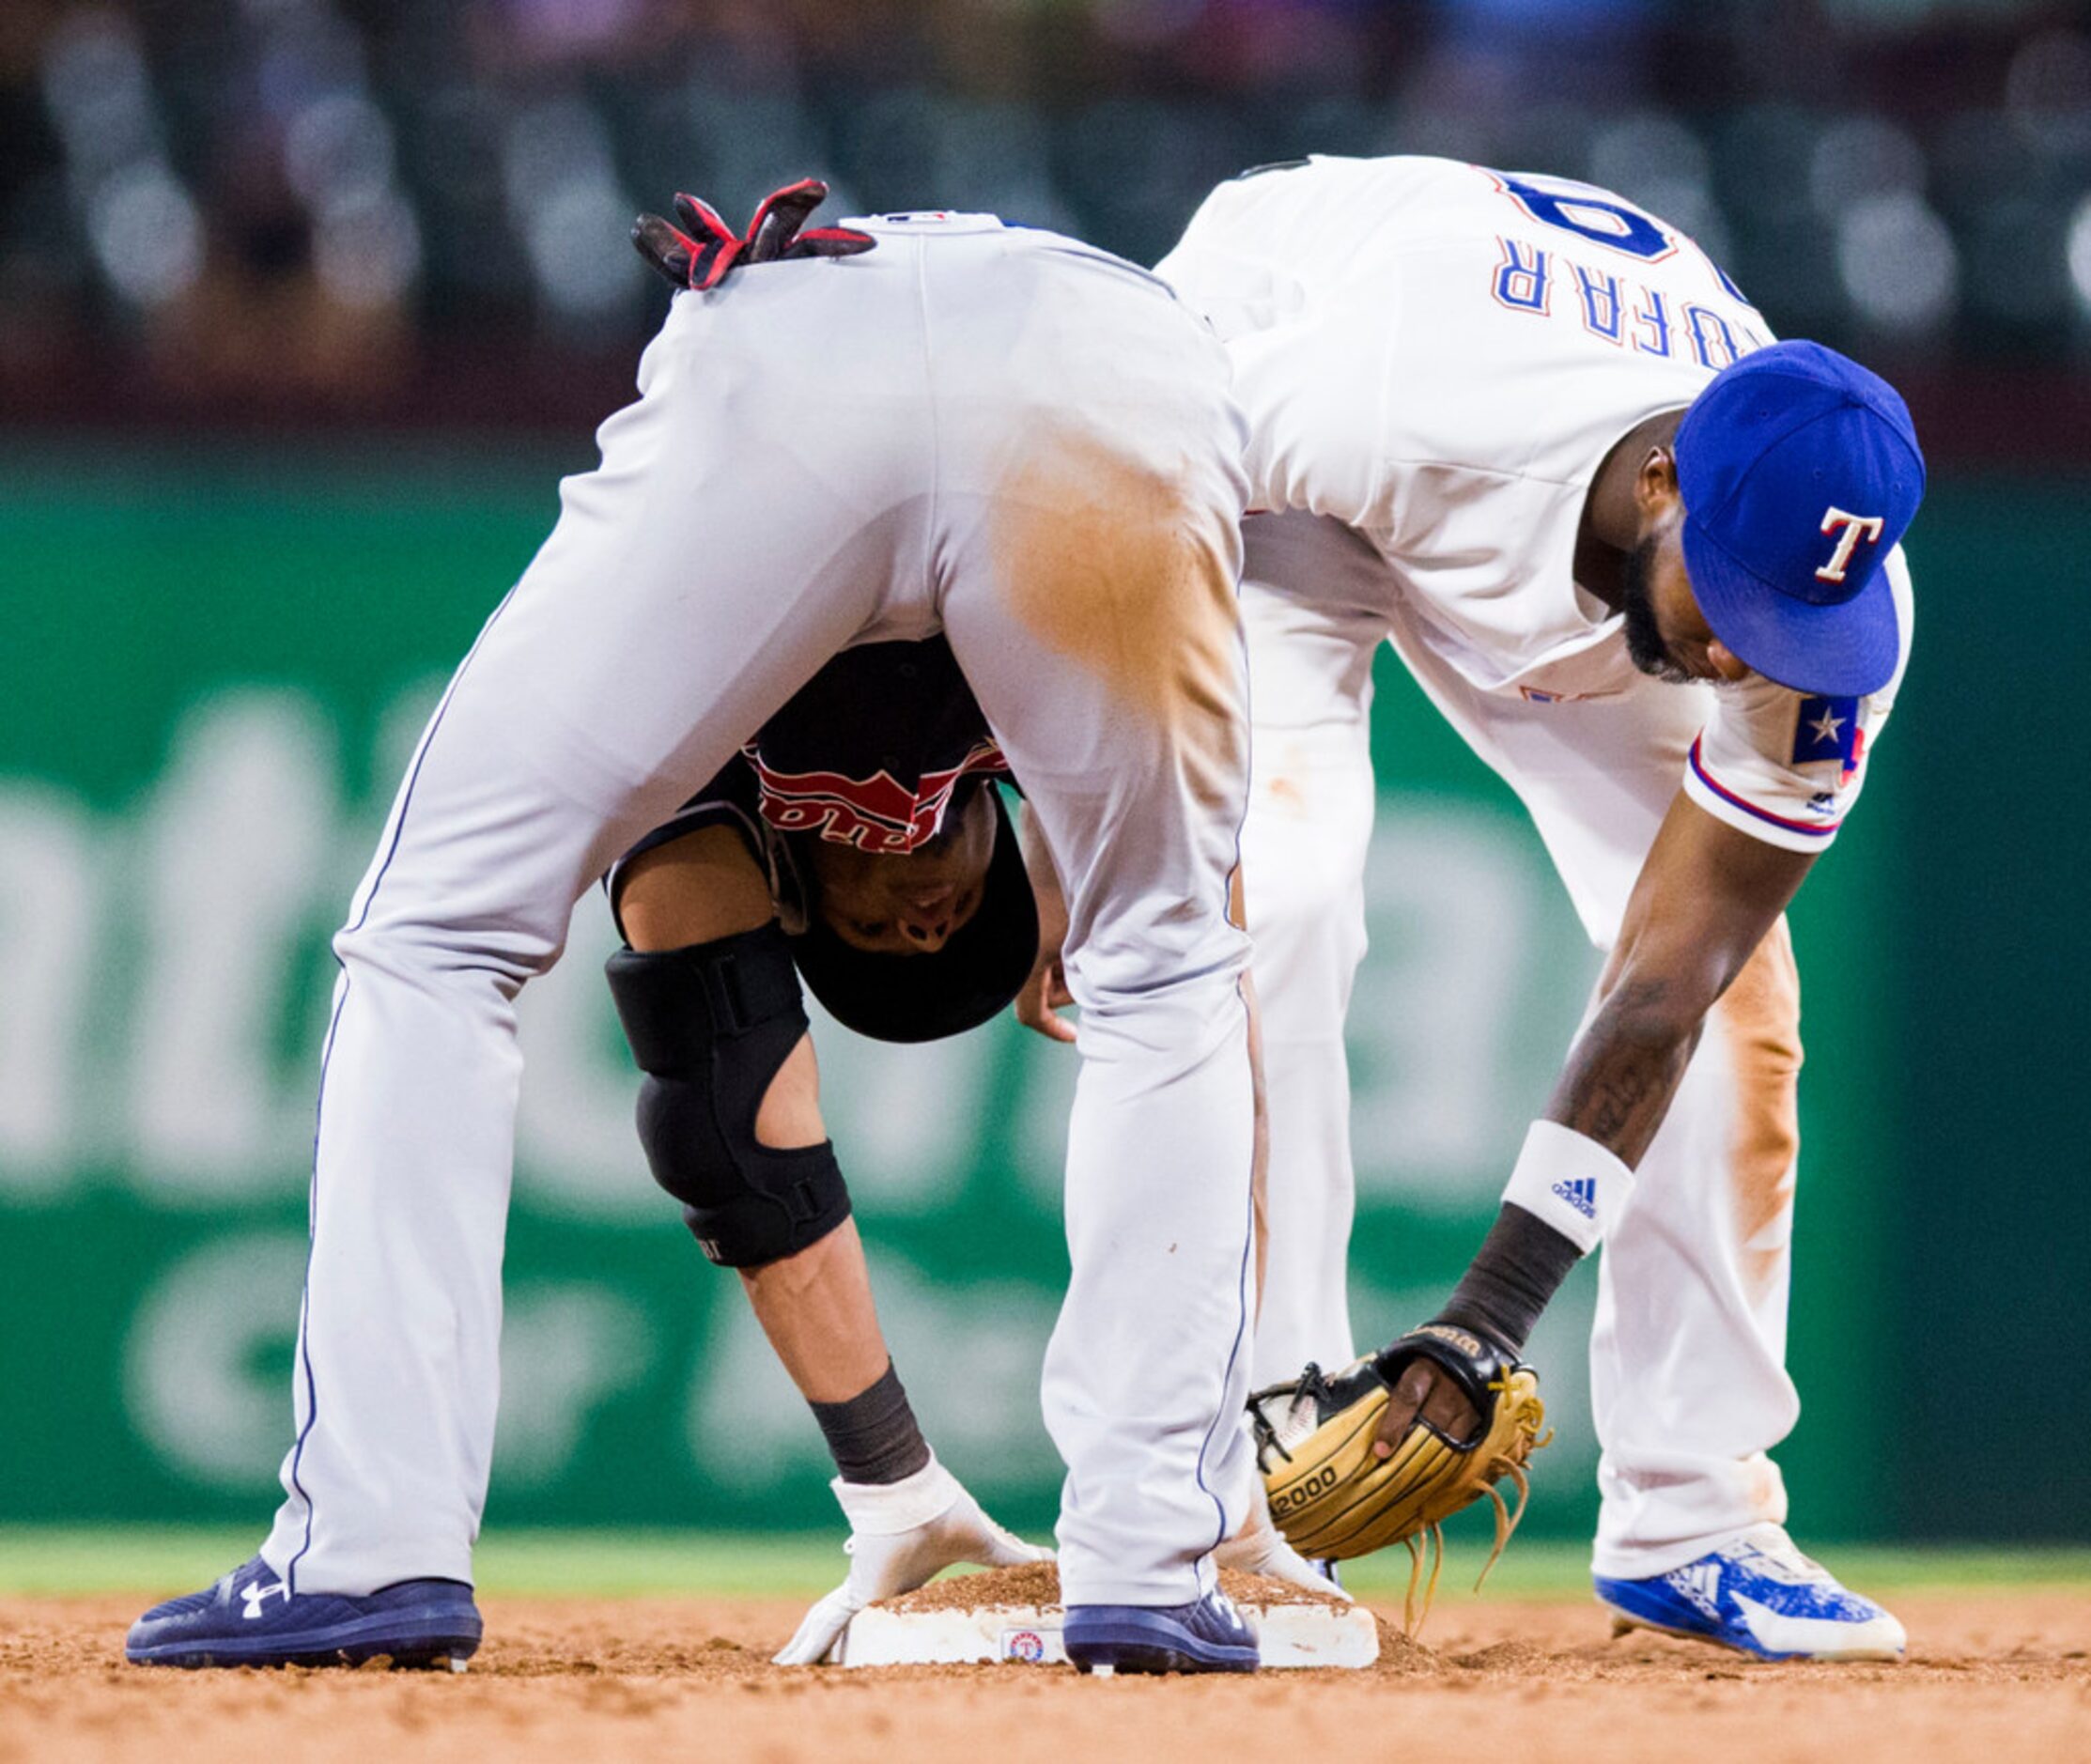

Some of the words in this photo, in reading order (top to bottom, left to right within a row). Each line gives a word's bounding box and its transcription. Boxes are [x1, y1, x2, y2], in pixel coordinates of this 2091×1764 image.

[1491, 235, 1764, 374] OFAR
[1815, 506, 1883, 585] T
[1269, 1466, 1337, 1516] 2000
